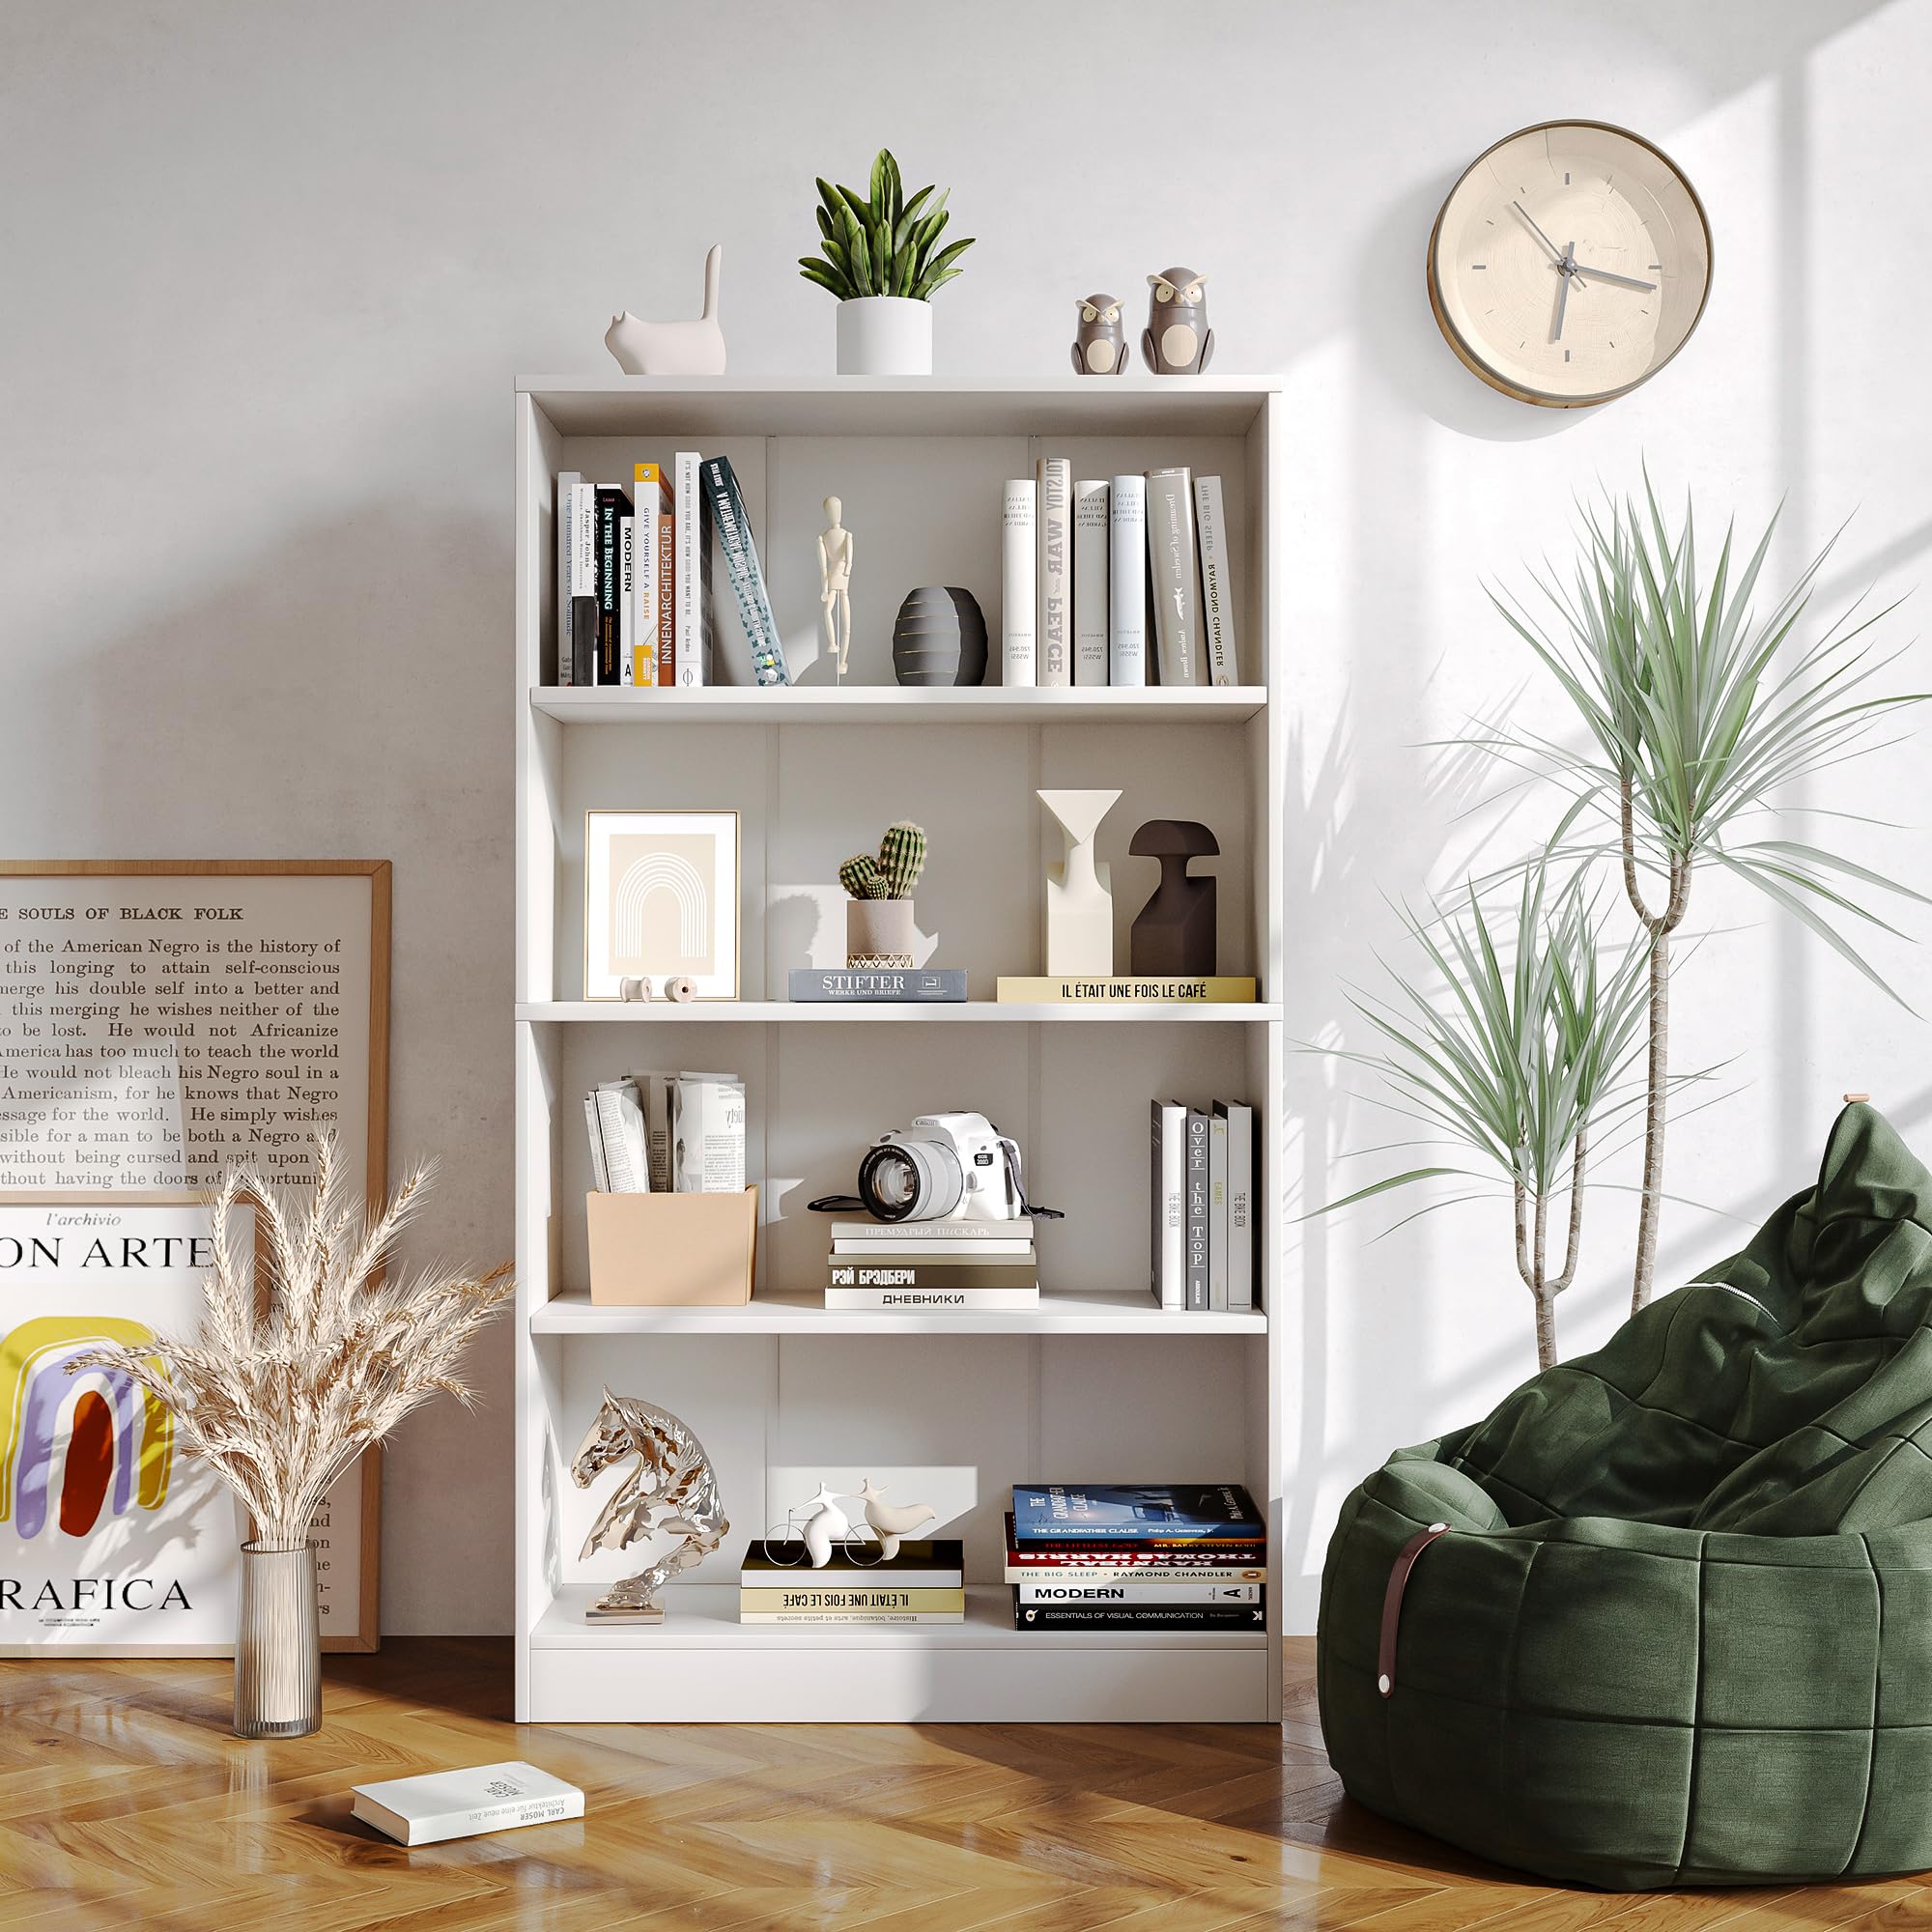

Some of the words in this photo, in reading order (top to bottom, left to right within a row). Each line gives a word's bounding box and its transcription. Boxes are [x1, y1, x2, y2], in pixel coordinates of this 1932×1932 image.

[661, 526, 671, 664] INNENARCHITEKTUR
[625, 665, 631, 676] A
[19, 908, 74, 920] SOULS
[86, 908, 109, 919] OF
[120, 908, 183, 920] BLACK
[194, 908, 243, 920] FOLK
[5, 939, 21, 952] of
[29, 940, 53, 952] the
[62, 940, 142, 952] American
[149, 939, 199, 956] Negro
[207, 940, 219, 952] is
[228, 940, 252, 952] the
[261, 940, 318, 956] history
[325, 939, 341, 952] of
[7, 961, 36, 973] this
[50, 960, 114, 978] longing
[130, 962, 146, 974] to
[162, 961, 210, 974] attain
[226, 960, 339, 974] self-conscious
[55, 981, 78, 994] his
[90, 981, 146, 994] double
[156, 981, 185, 994] self
[195, 981, 227, 994] into
[254, 981, 303, 994] better
[310, 981, 339, 994] and
[822, 976, 904, 989] STIFTER
[1063, 984, 1071, 998] IL
[1075, 982, 1106, 998] ÉTAIT
[1109, 984, 1131, 998] UNE
[1134, 984, 1159, 998] FOIS
[1162, 984, 1175, 998] LE
[1179, 981, 1207, 998] CAFÉ
[13, 1003, 43, 1015] this
[51, 1003, 120, 1019] merging
[130, 1003, 149, 1015] he
[157, 1003, 212, 1015] wishes
[220, 1003, 278, 1015] neither
[286, 1003, 302, 1015] of
[314, 1003, 339, 1015] the
[23, 1023, 40, 1036] be
[52, 1023, 86, 1037] lost.
[108, 1023, 132, 1037] He
[144, 1023, 194, 1037] would
[210, 1025, 237, 1037] not
[250, 1023, 338, 1037] Africanize
[66, 1044, 93, 1057] has
[100, 1045, 126, 1057] too
[133, 1044, 179, 1057] much
[185, 1046, 200, 1057] to
[208, 1044, 251, 1058] teach
[260, 1044, 285, 1058] the
[291, 1044, 338, 1058] world
[26, 1065, 76, 1078] would
[85, 1067, 109, 1078] not
[119, 1065, 171, 1079] bleach
[179, 1065, 202, 1078] his
[207, 1065, 259, 1083] Negro
[266, 1065, 299, 1079] soul
[306, 1065, 323, 1078] in
[2, 1087, 119, 1101] Americanism,
[126, 1086, 150, 1099] for
[157, 1087, 174, 1099] he
[185, 1086, 239, 1099] knows
[246, 1087, 280, 1099] that
[287, 1086, 338, 1104] Negro
[52, 1107, 76, 1121] for
[83, 1107, 108, 1121] the
[117, 1107, 169, 1121] world.
[190, 1107, 214, 1121] He
[221, 1108, 276, 1124] simply
[283, 1108, 337, 1121] wishes
[1192, 1122, 1204, 1168] Over
[80, 1237, 214, 1268] ARTE
[1193, 1226, 1204, 1265] Top
[832, 1266, 854, 1285] РЭЙ
[859, 1269, 916, 1286] БРЭДБЕРИ
[882, 1294, 965, 1304] ДНЕВНИКИ
[0, 1578, 193, 1610] RAFICA
[810, 1594, 822, 1606] LE
[825, 1594, 845, 1606] FOIS
[848, 1594, 867, 1606] UNE
[899, 1594, 908, 1606] IL
[1036, 1589, 1124, 1598] MODERN
[1223, 1589, 1240, 1598] A
[782, 1594, 808, 1608] CAFÉ
[870, 1594, 897, 1608] ÉTAIT
[529, 1799, 565, 1810] Architektur
[548, 1807, 564, 1816] CARL
[521, 1810, 545, 1820] MOSER
